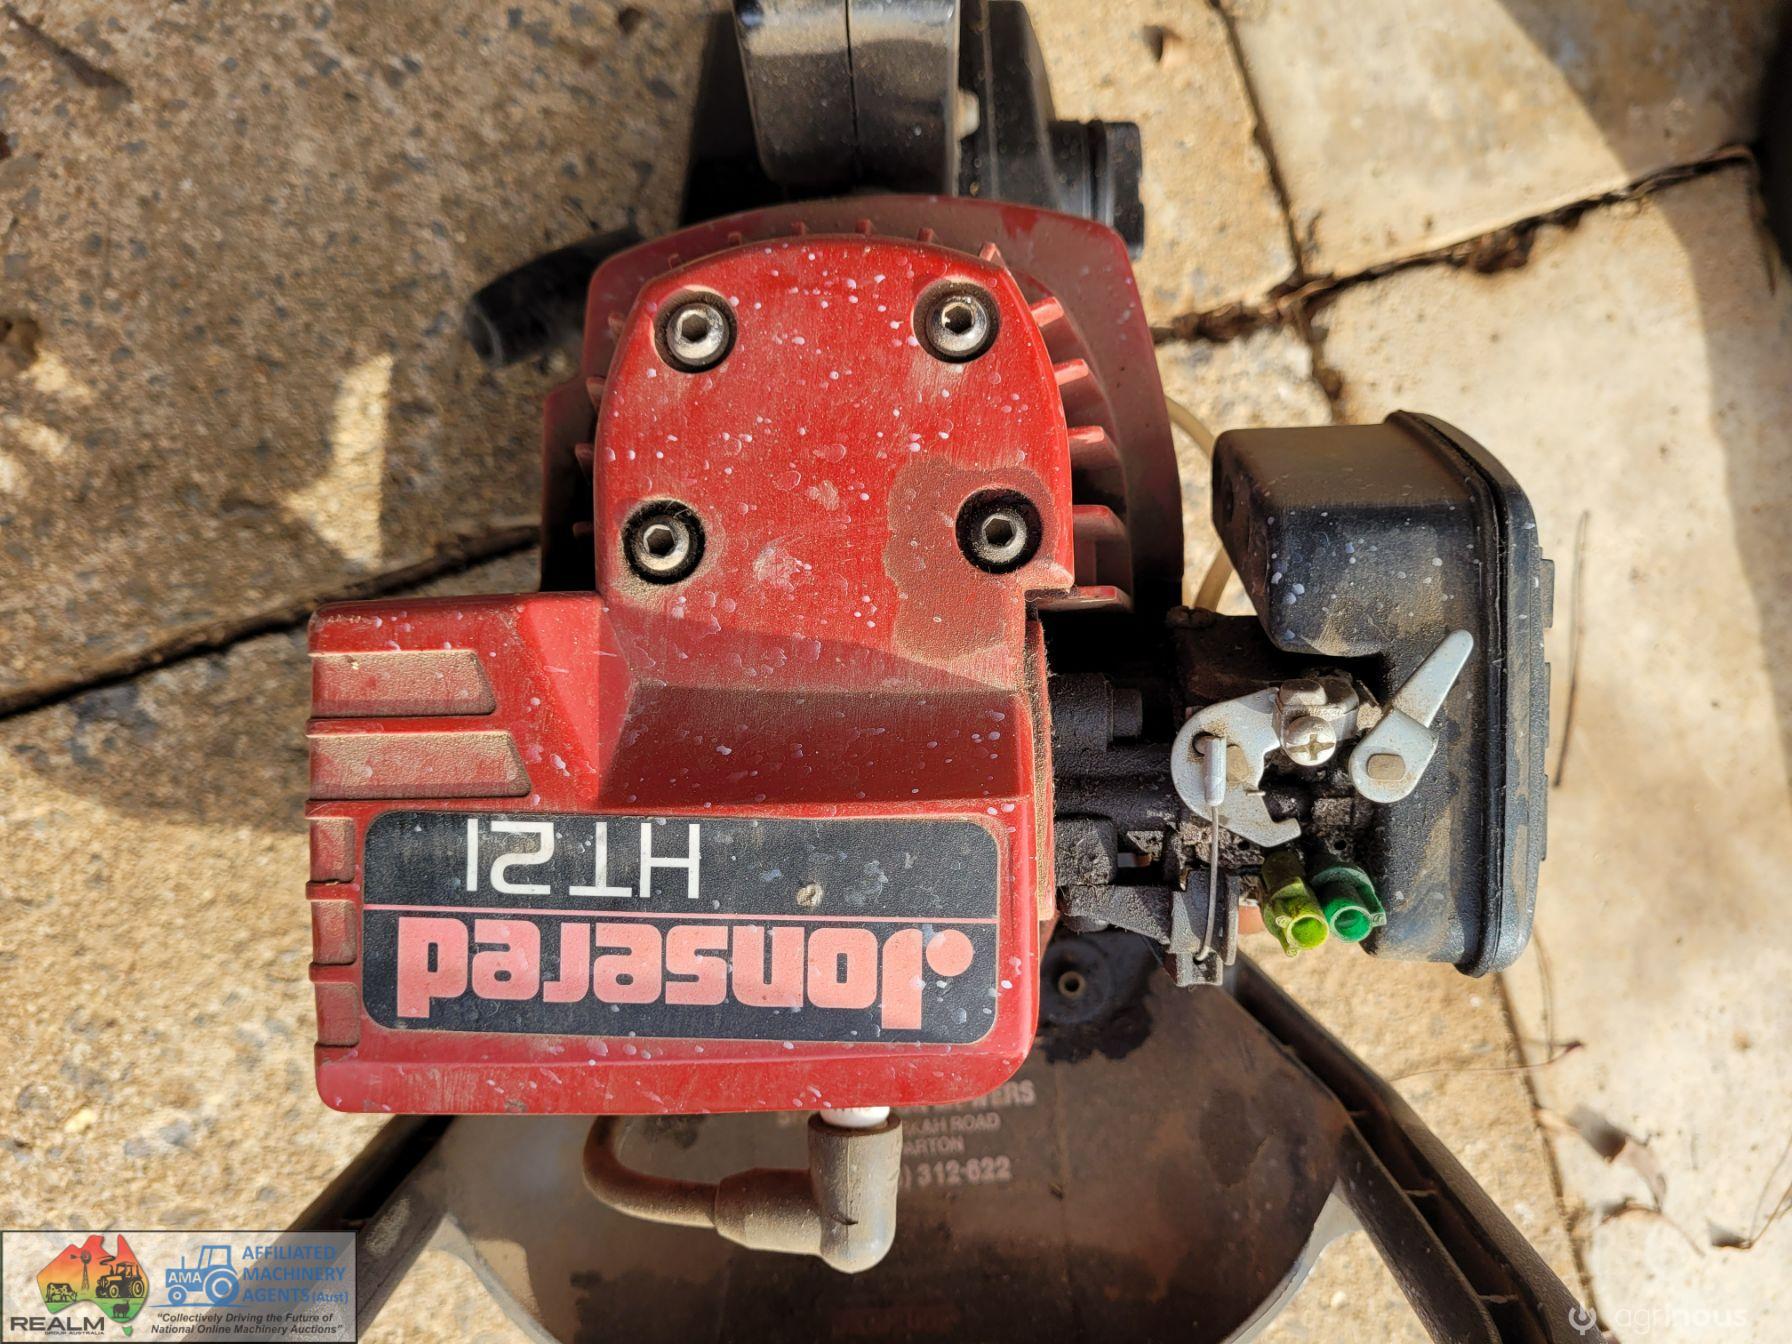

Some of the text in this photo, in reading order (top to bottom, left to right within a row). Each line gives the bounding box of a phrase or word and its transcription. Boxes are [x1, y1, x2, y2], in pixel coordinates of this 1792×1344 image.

[397, 916, 974, 1030] Jonsered
[950, 1112, 1001, 1132] ROAD
[902, 1135, 966, 1156] ARTON
